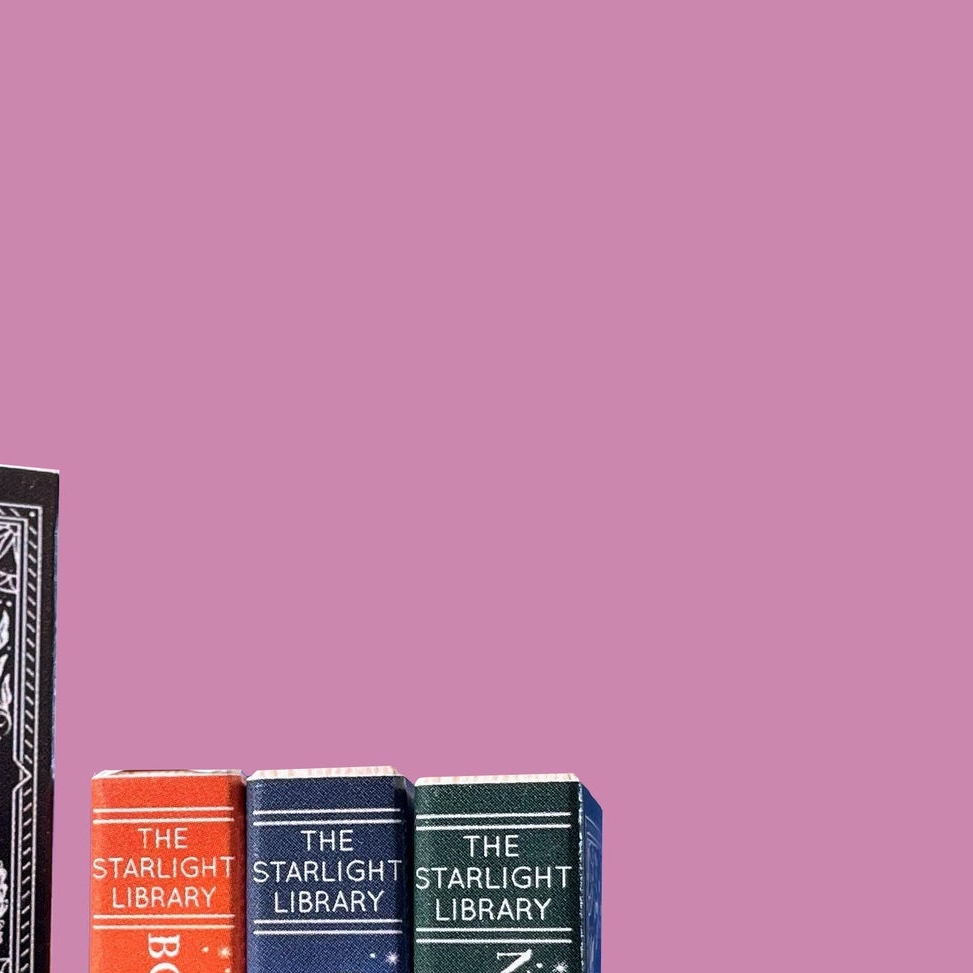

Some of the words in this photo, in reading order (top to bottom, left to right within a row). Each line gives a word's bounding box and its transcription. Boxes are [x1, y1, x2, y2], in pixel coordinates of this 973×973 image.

[137, 827, 188, 850] THE
[300, 829, 354, 852] THE
[462, 834, 519, 858] THE
[92, 855, 235, 880] STARLIGHT
[252, 858, 402, 883] STARLIGHT
[415, 865, 573, 891] STARLIGHT
[112, 886, 216, 909] LIBRARY
[274, 890, 385, 914] LIBRARY
[435, 897, 552, 922] LIBRARY
